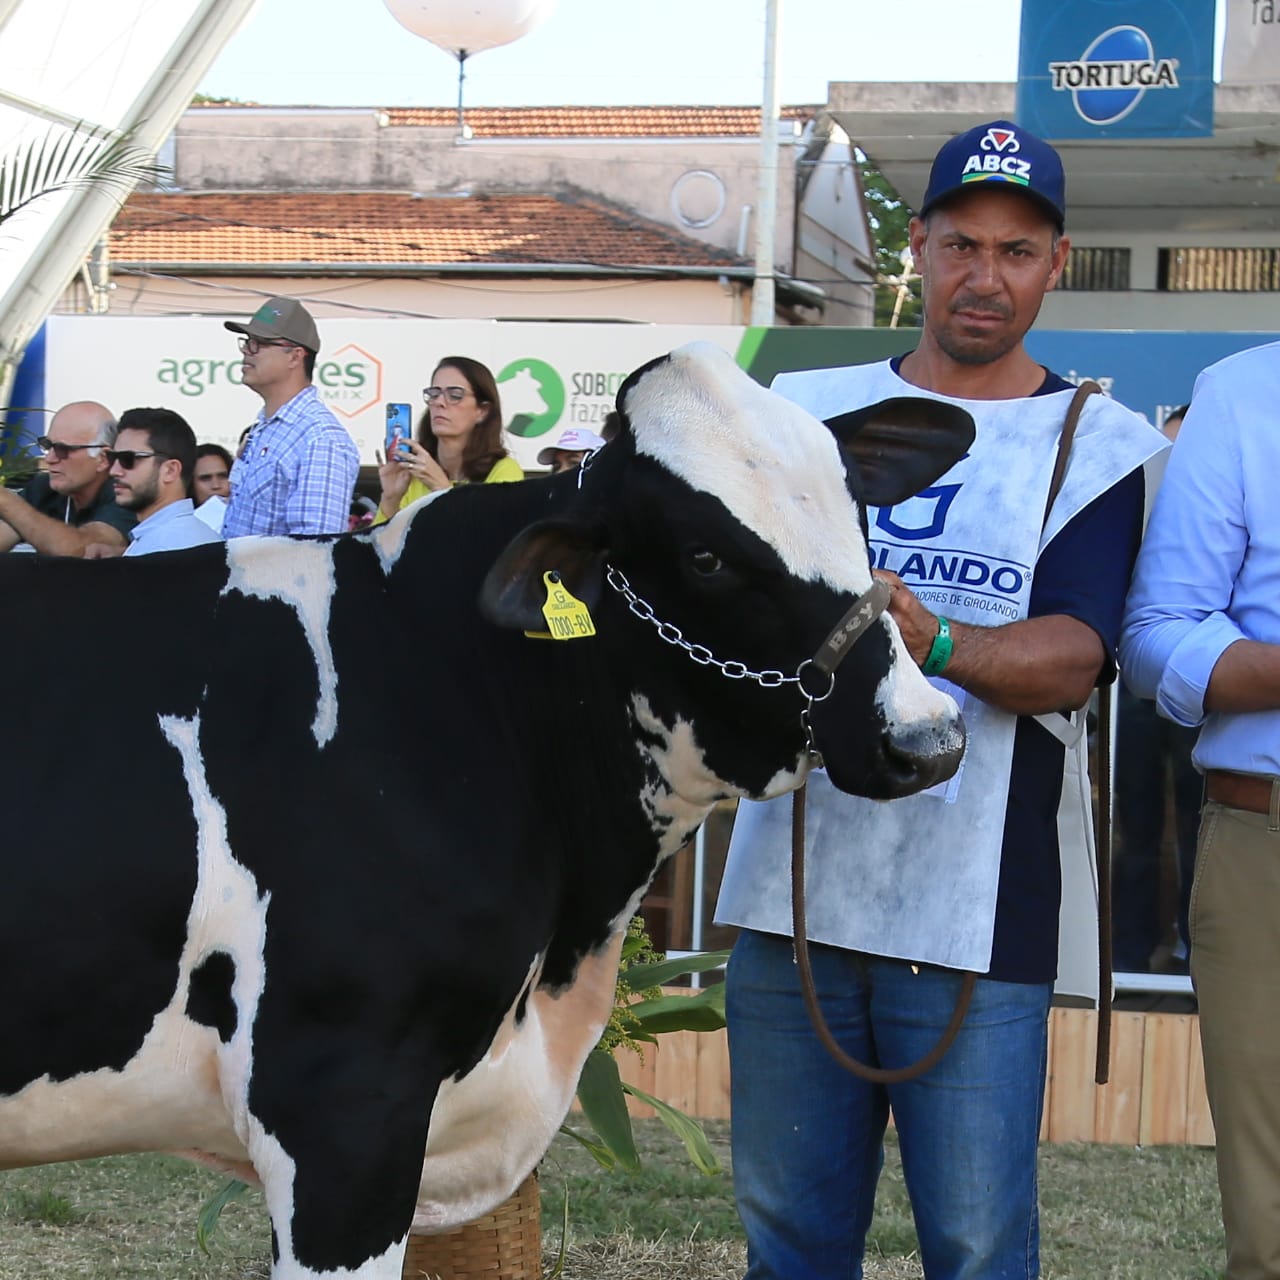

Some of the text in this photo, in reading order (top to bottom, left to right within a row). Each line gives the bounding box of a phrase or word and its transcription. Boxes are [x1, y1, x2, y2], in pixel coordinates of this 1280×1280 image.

[1051, 60, 1177, 88] TORTUGA
[962, 154, 1032, 180] ABCZ
[570, 396, 612, 423] faze
[950, 593, 962, 606] DE
[963, 596, 1019, 620] GIROLANDO
